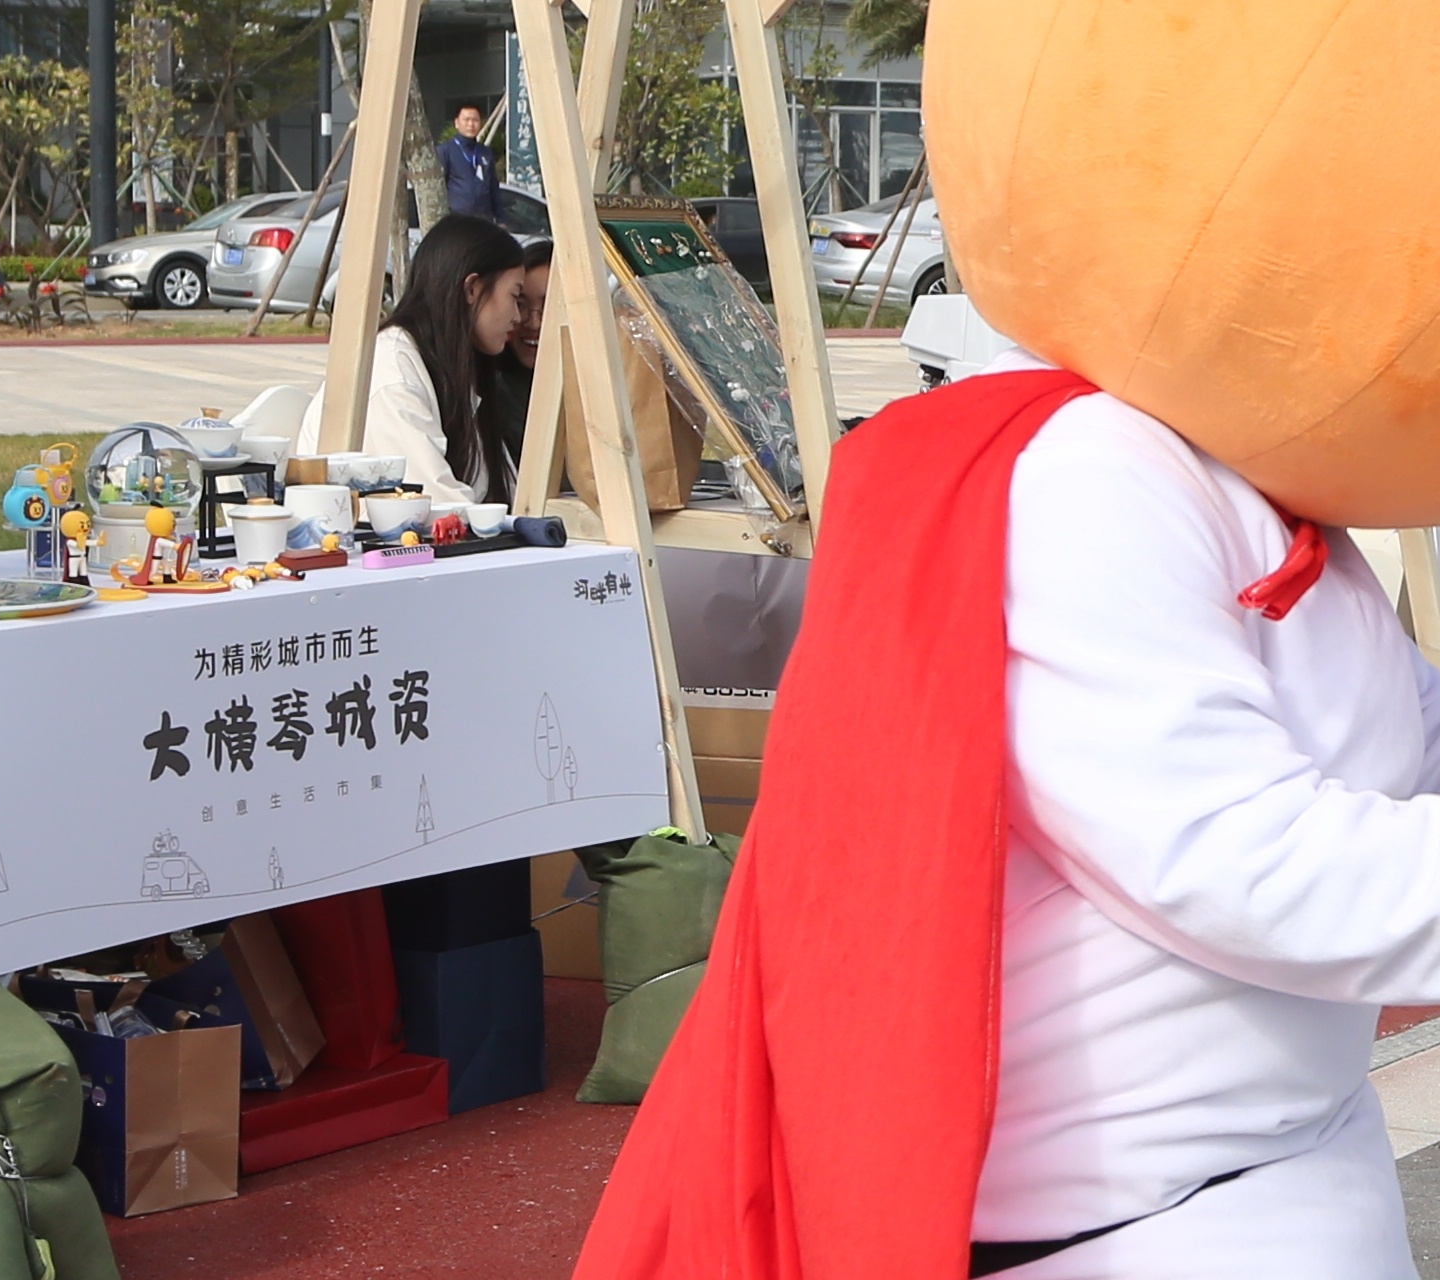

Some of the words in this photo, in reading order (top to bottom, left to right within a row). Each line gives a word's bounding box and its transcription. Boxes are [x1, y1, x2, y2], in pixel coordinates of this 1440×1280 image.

[573, 570, 633, 605] 河畔有光
[193, 625, 380, 681] 为精彩城市而生
[142, 669, 430, 782] 大横琴城资
[200, 774, 383, 823] 创意生活市集
